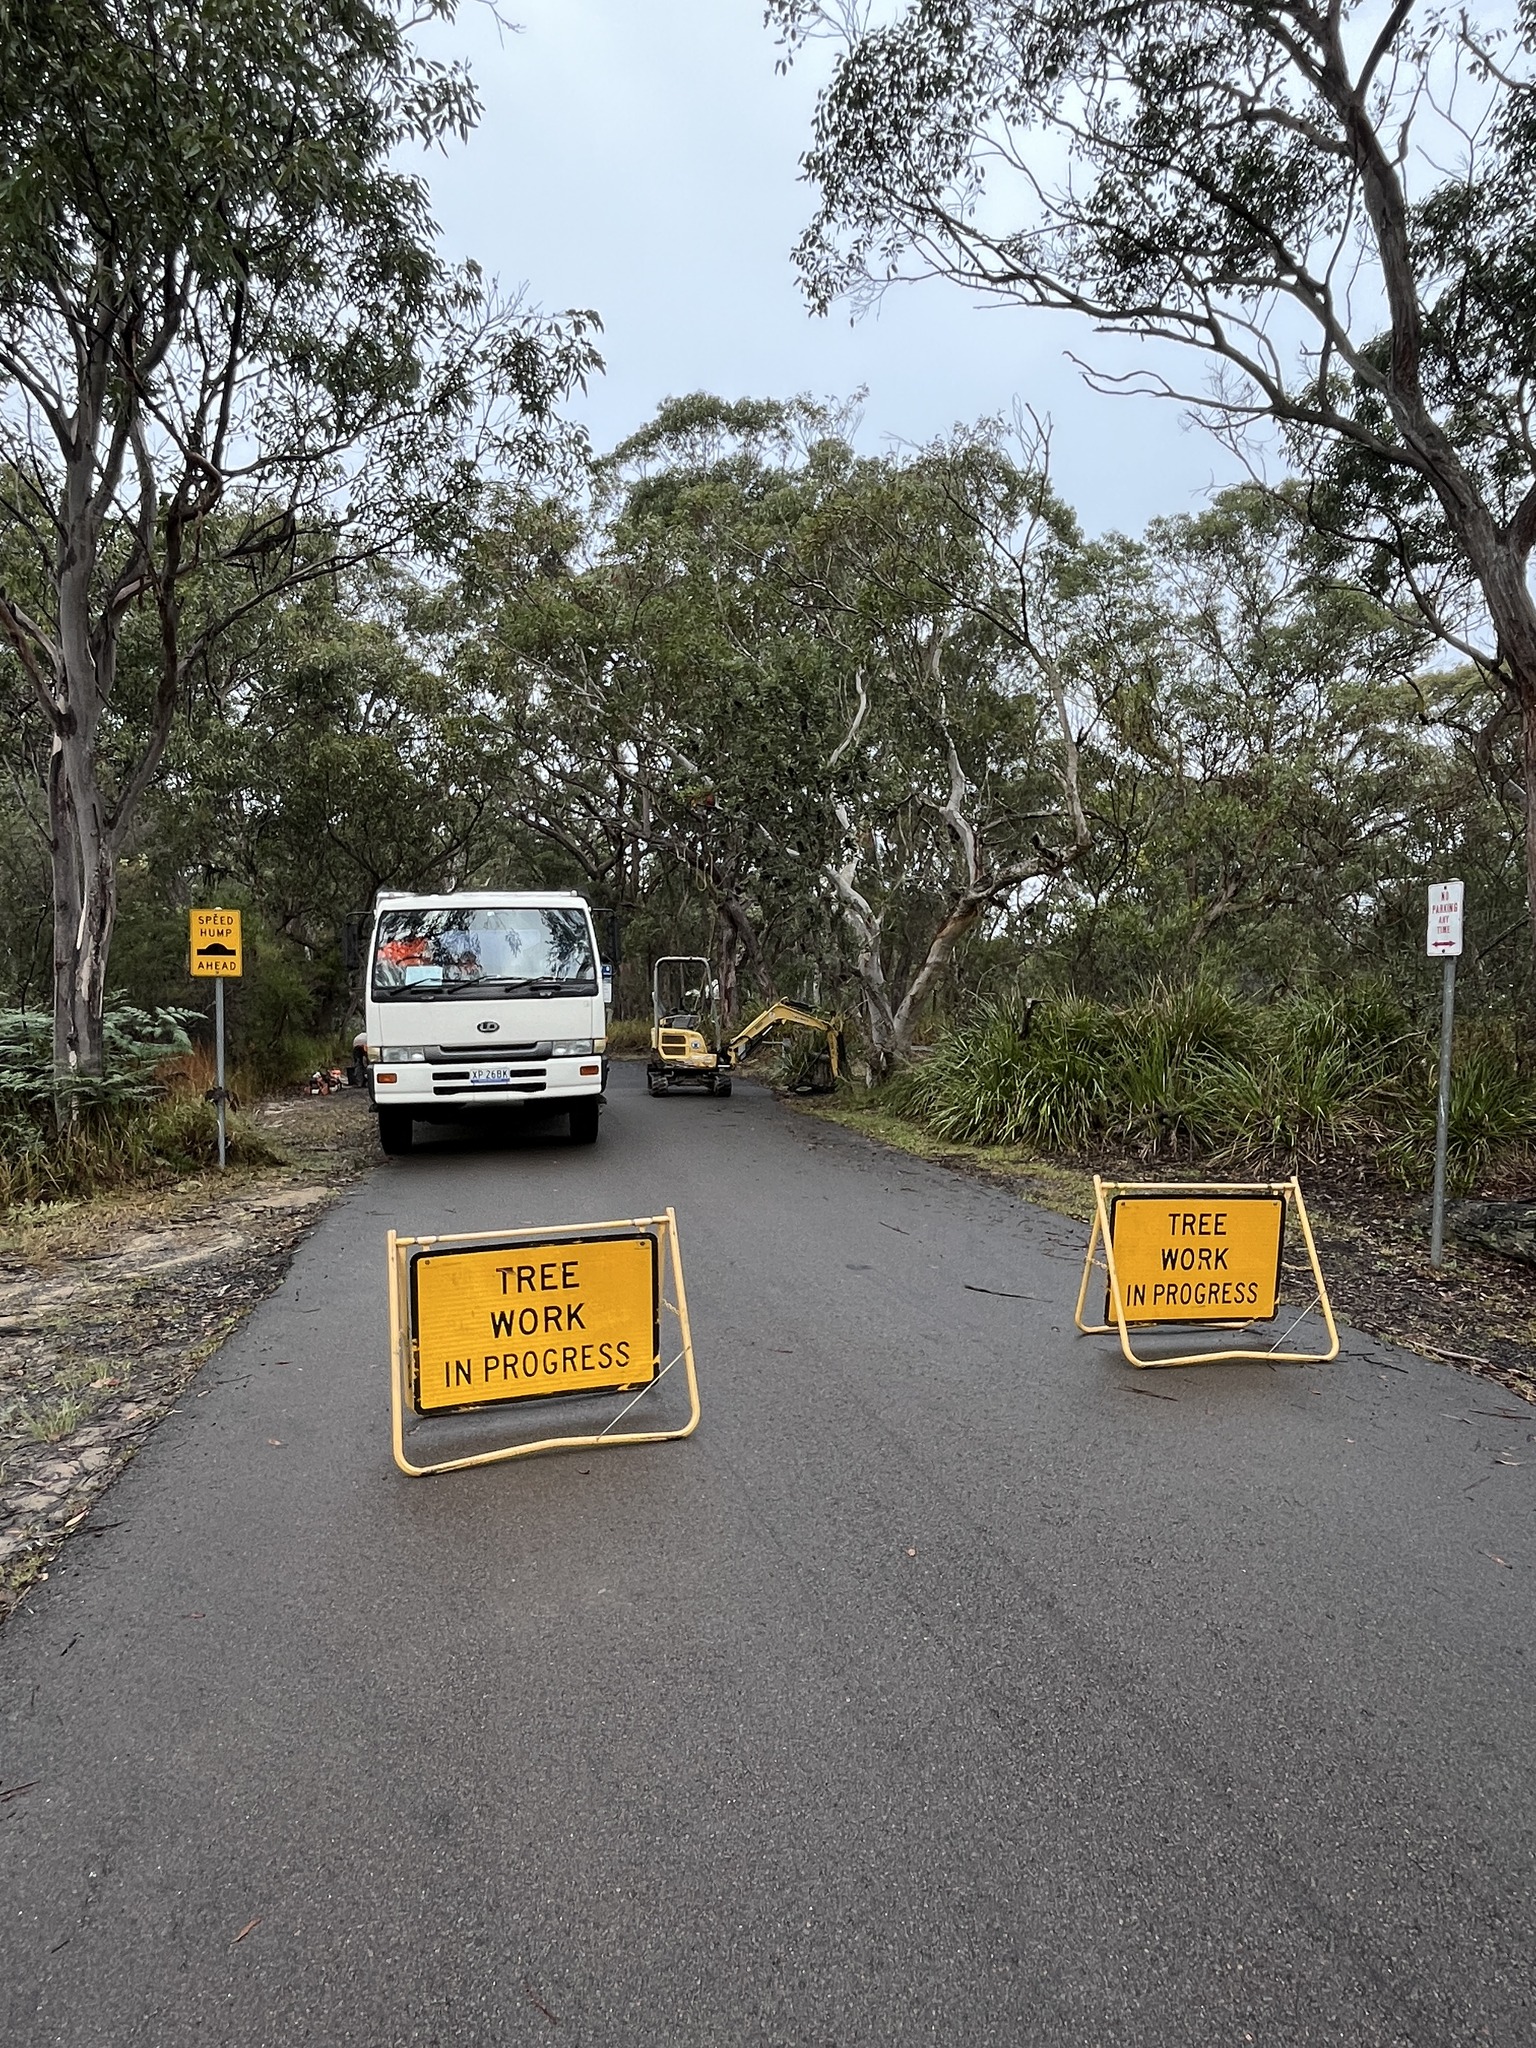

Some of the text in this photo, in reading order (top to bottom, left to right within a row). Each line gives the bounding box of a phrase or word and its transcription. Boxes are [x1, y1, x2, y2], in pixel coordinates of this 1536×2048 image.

[1441, 891, 1449, 901] NO
[1432, 903, 1458, 914] PARKING
[198, 915, 234, 925] SPEED
[200, 928, 232, 938] HUMP
[1437, 926, 1450, 934] TIME
[198, 961, 236, 971] AHEAD
[1168, 1213, 1228, 1236] TREE
[1161, 1248, 1229, 1271] WORK
[496, 1261, 580, 1295] TREE
[1126, 1282, 1258, 1307] IN PROGRESS
[490, 1303, 586, 1339] WORK
[445, 1341, 630, 1388] IN PROGRESS
